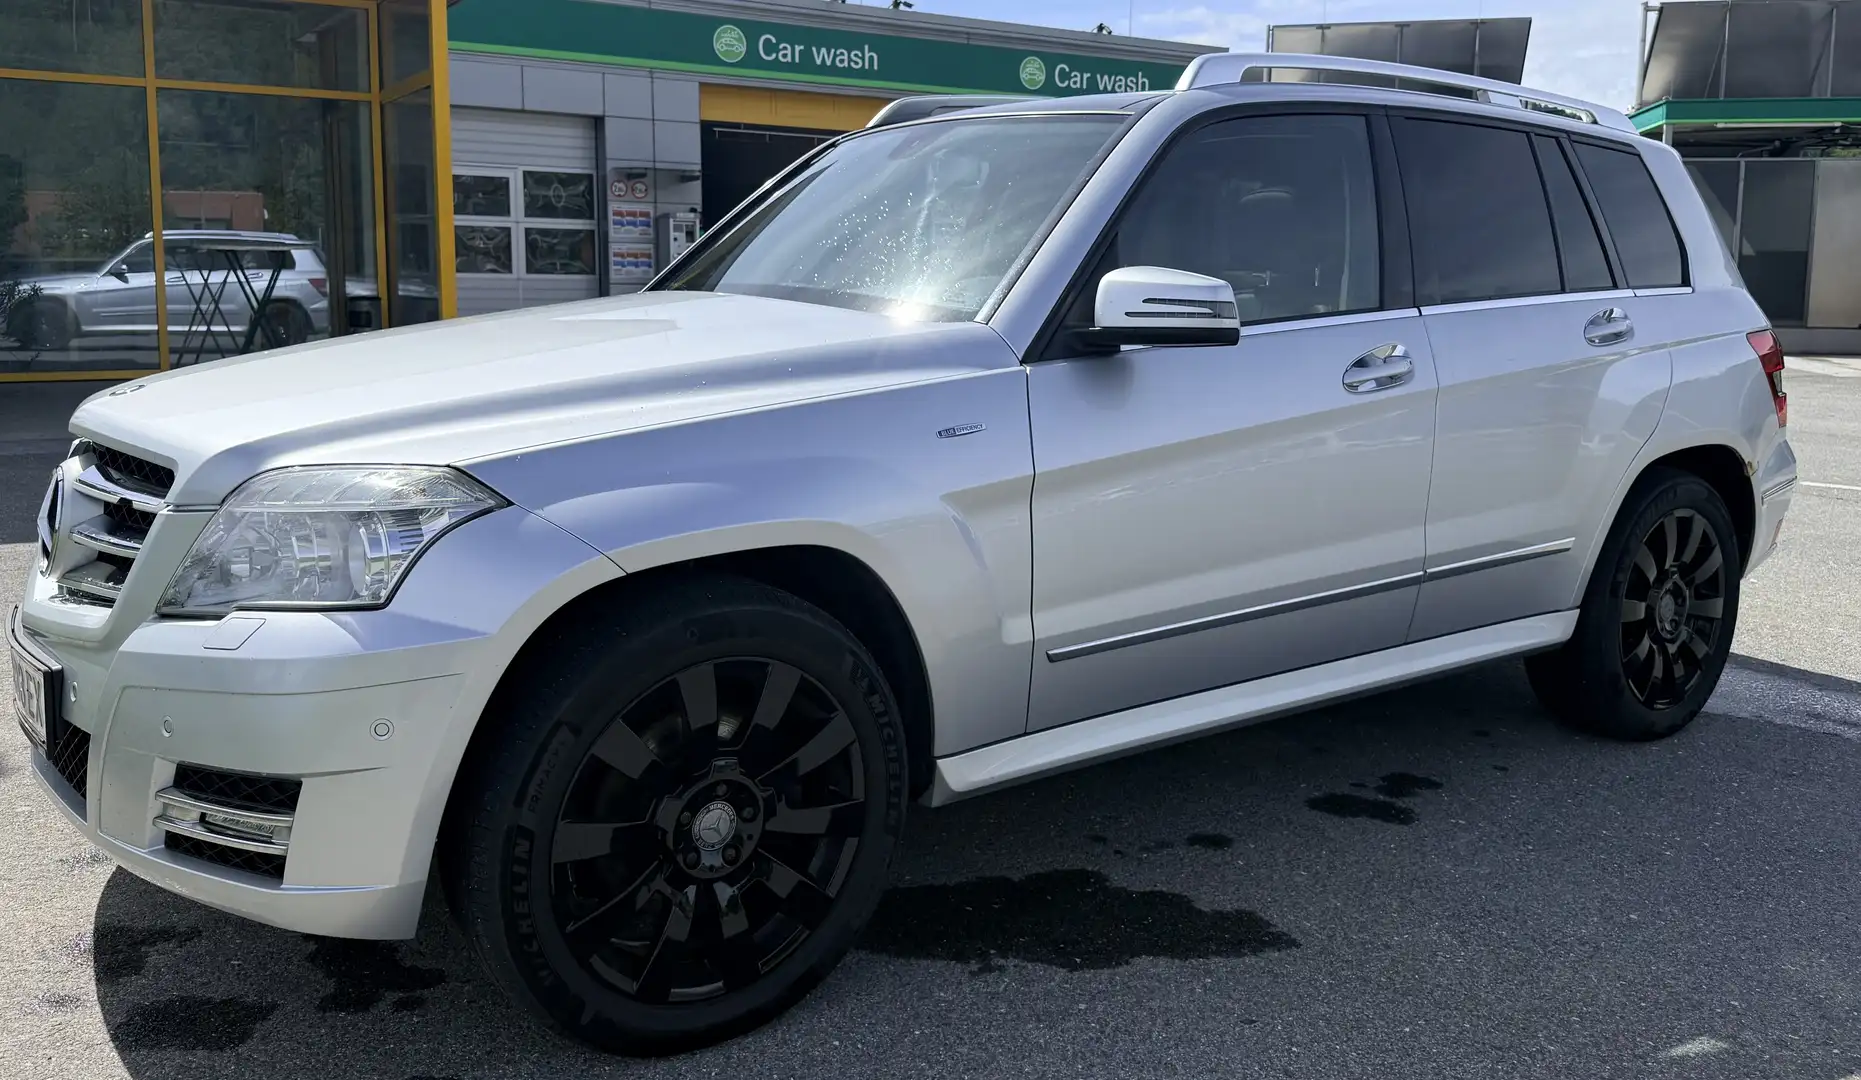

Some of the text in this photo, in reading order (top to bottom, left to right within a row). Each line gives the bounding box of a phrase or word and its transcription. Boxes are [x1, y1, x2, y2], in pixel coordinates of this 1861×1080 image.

[758, 33, 878, 71] Car wash
[1054, 63, 1149, 93] Car wash
[527, 738, 566, 814] PRIMACY
[869, 692, 902, 827] MICHELIN
[510, 837, 558, 987] MICHELIN
